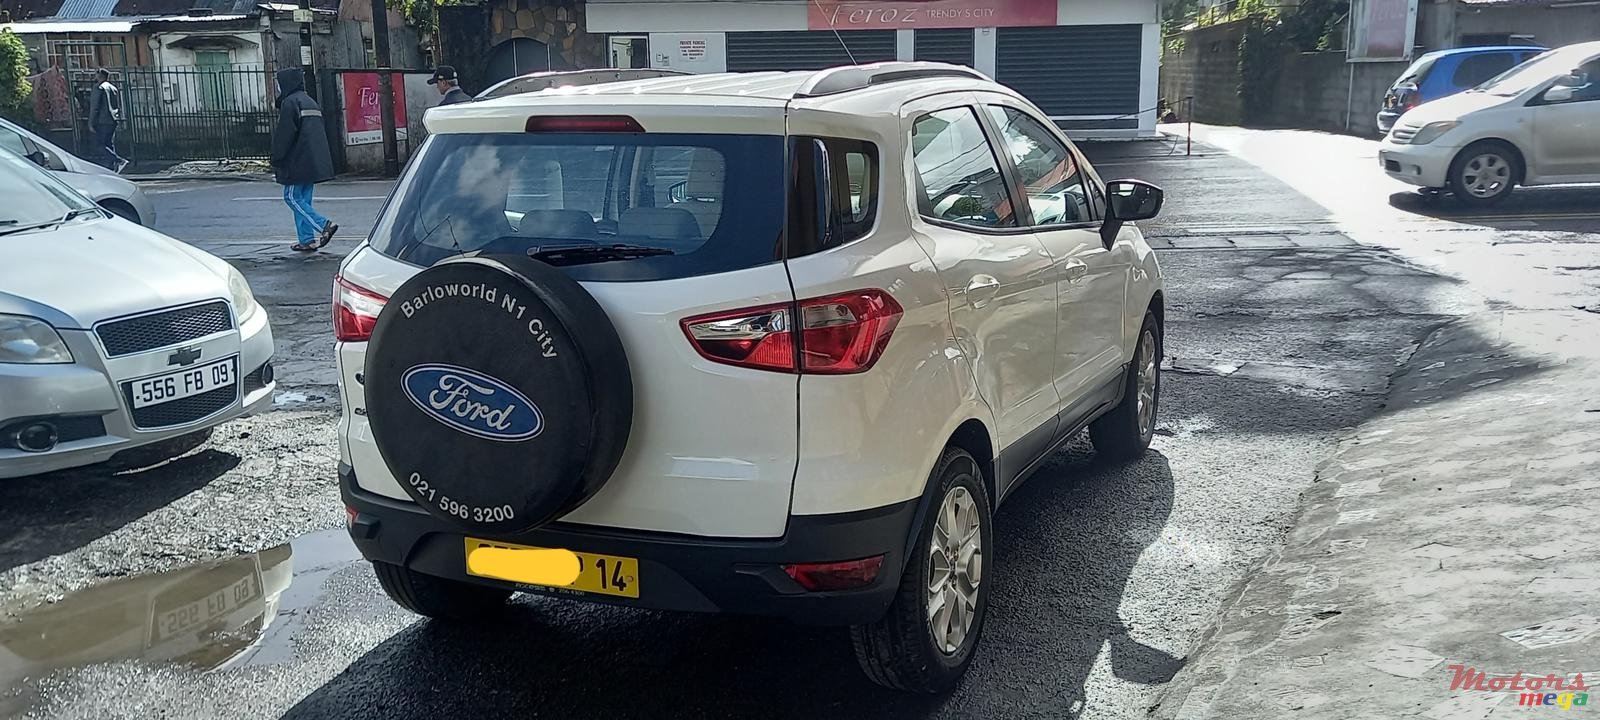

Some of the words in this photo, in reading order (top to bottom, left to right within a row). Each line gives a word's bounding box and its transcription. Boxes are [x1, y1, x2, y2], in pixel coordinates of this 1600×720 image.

[826, 4, 918, 26] Feroz
[973, 8, 995, 18] CITY
[400, 283, 497, 319] Barloworld
[501, 293, 527, 319] N1
[528, 318, 558, 359] City
[142, 377, 176, 402] 556
[184, 371, 204, 393] FB
[212, 364, 229, 386] 09
[429, 374, 515, 431] Ford
[409, 472, 437, 502] 021
[439, 497, 469, 519] 596
[473, 504, 514, 523] 3200
[596, 559, 627, 591] 14
